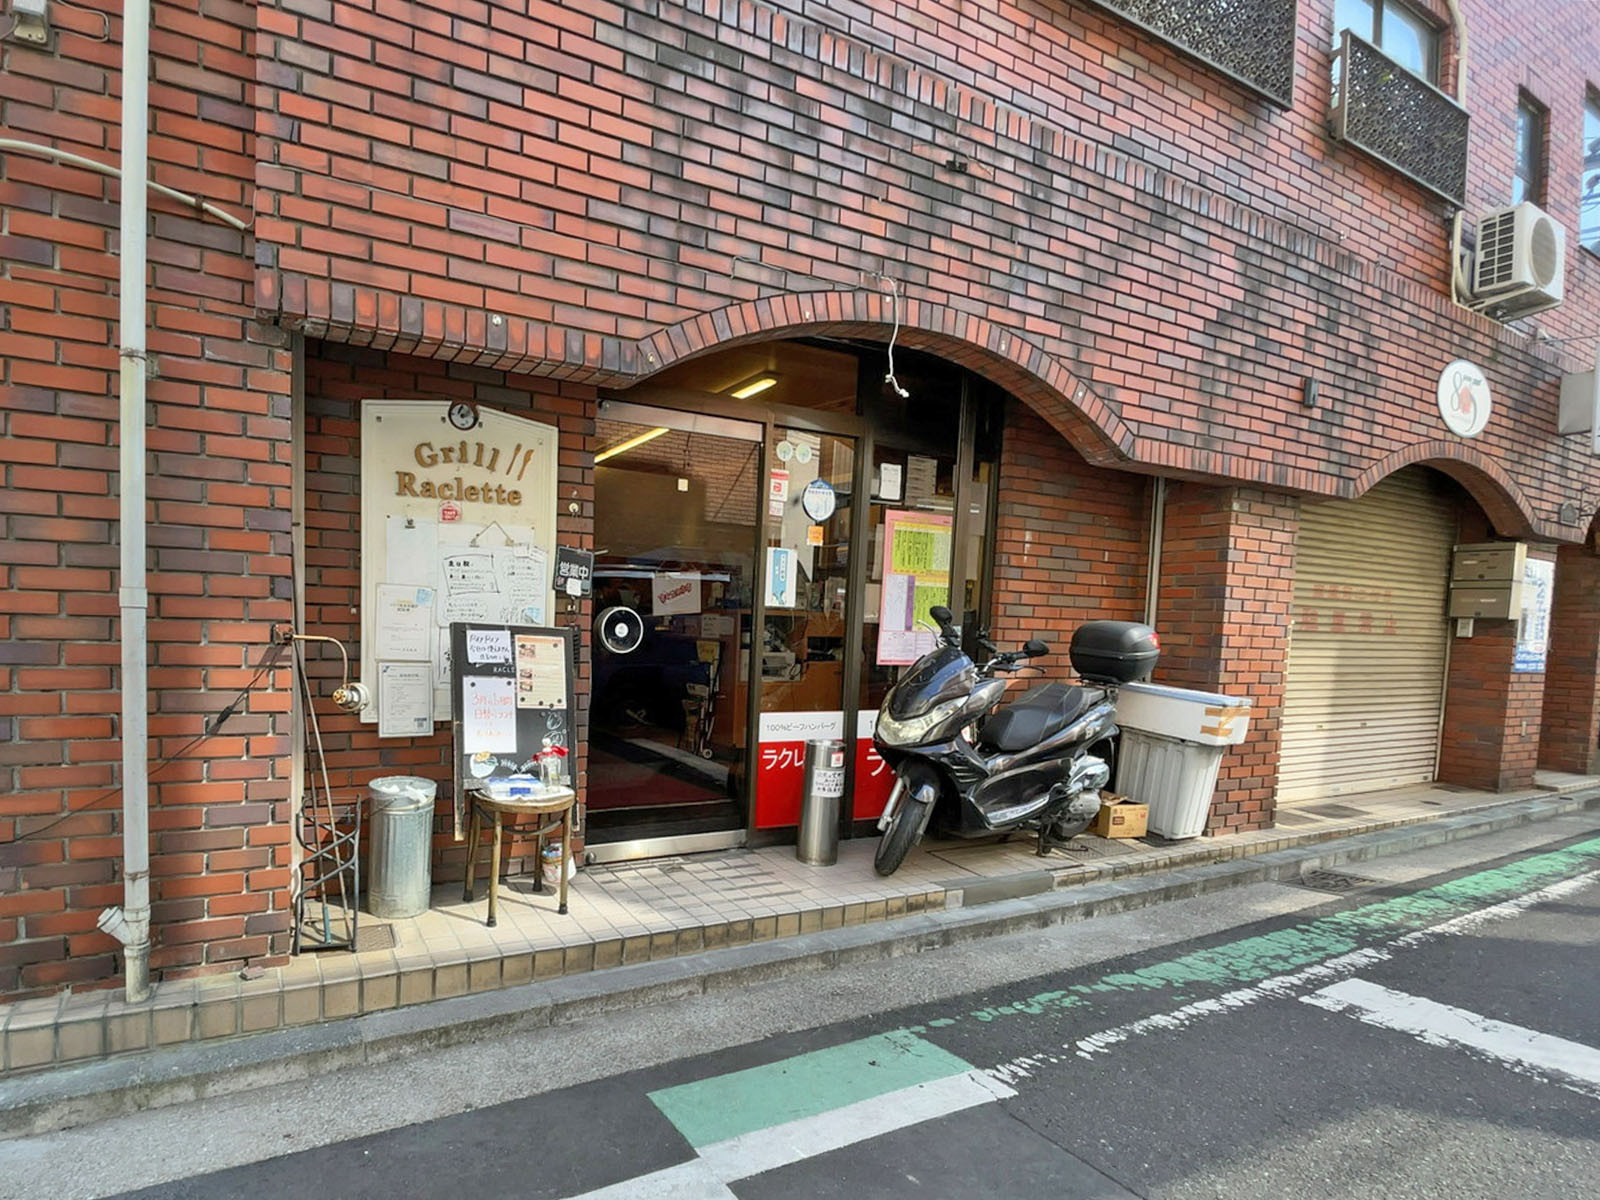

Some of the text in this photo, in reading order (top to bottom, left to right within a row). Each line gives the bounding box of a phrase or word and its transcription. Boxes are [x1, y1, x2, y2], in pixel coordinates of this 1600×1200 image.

[414, 440, 500, 472] Grill
[395, 470, 522, 506] Raclette
[560, 561, 588, 579] 営業中
[767, 722, 837, 732] 100%ビーフハンバーグ
